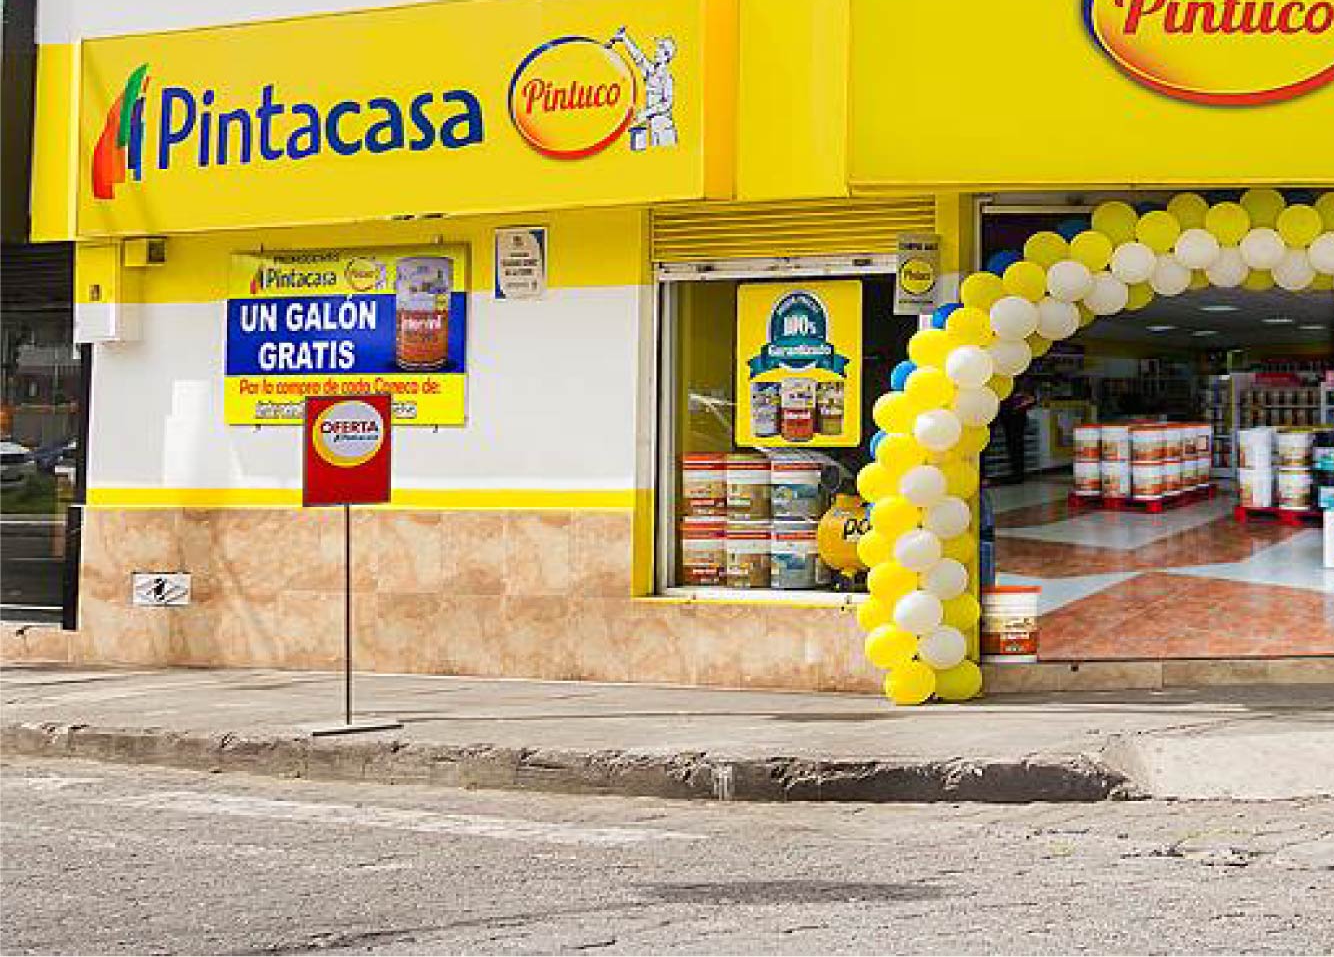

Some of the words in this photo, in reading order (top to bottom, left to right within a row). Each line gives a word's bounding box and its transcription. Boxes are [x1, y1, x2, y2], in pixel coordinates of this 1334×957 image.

[522, 77, 621, 115] Pintuco
[158, 81, 486, 170] Pintacasa
[265, 268, 337, 289] Pintacasa
[240, 303, 278, 332] UN
[286, 294, 377, 330] GALÓN
[258, 341, 356, 370] GRATIS
[321, 421, 379, 433] OFERTA
